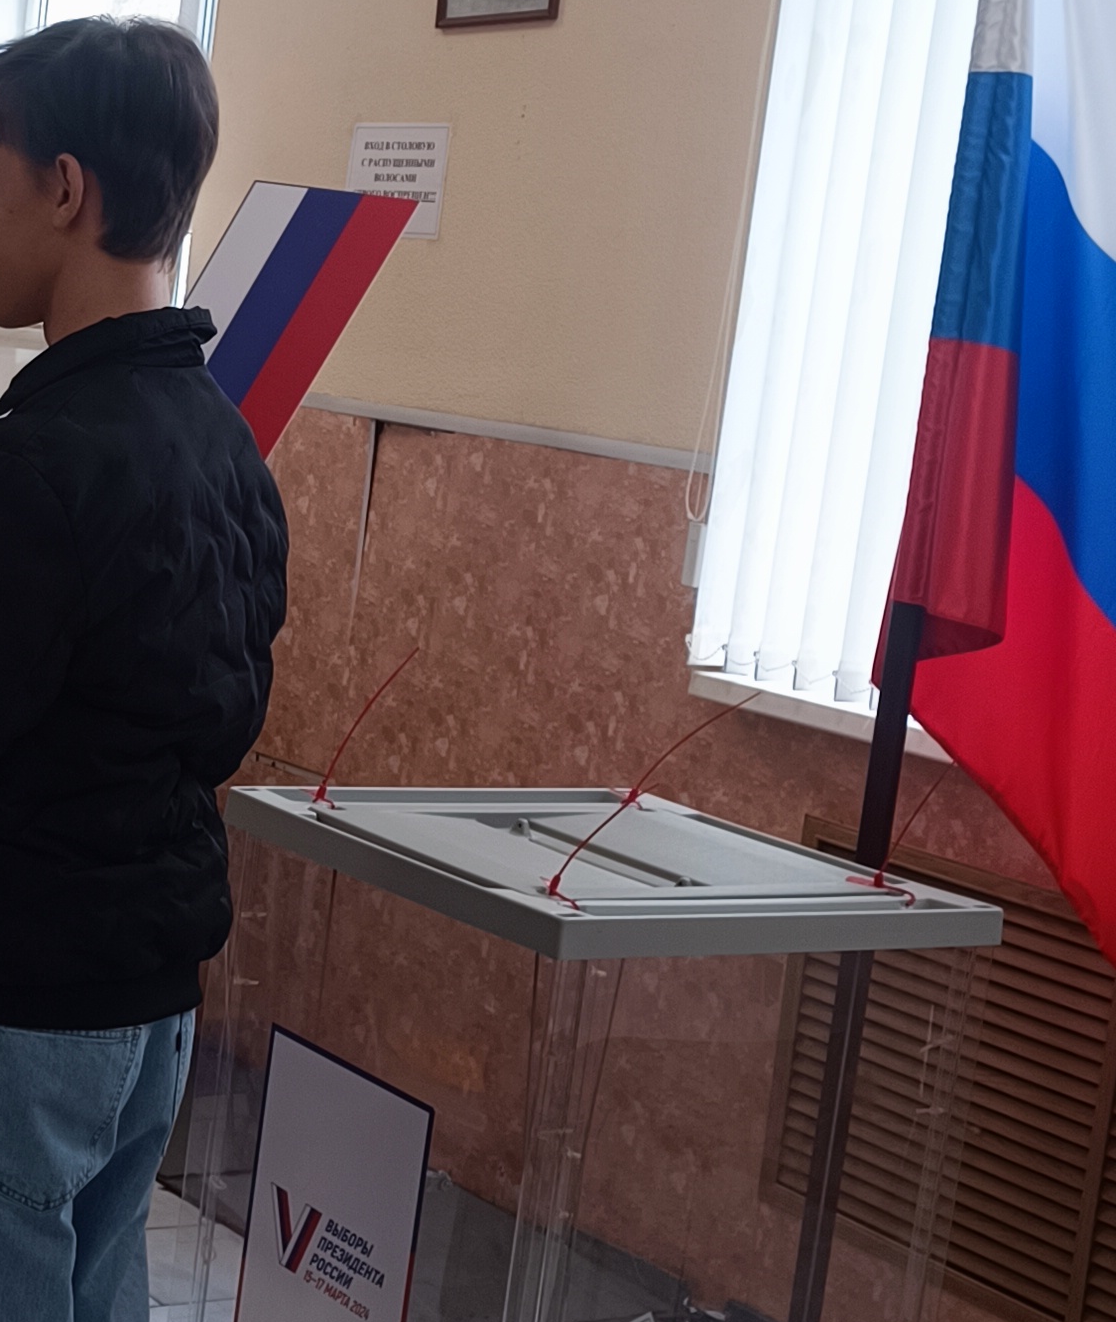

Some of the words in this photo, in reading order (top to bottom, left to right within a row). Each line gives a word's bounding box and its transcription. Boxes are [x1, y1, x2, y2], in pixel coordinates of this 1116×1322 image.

[361, 158, 368, 167] С
[368, 158, 436, 168] РАСПУЩЕННЫМИ
[364, 141, 384, 151] ВХОД
[391, 141, 435, 151] СТОЛОВУЮ
[374, 173, 417, 183] ВОЛОСАМИ
[325, 1218, 374, 1258] ВЫБОРЫ
[309, 1253, 354, 1290] РОССИИ
[317, 1236, 385, 1289] ПРЕЗИДЕНТА
[323, 1283, 351, 1309] МАРТА
[349, 1299, 371, 1321] 2024
